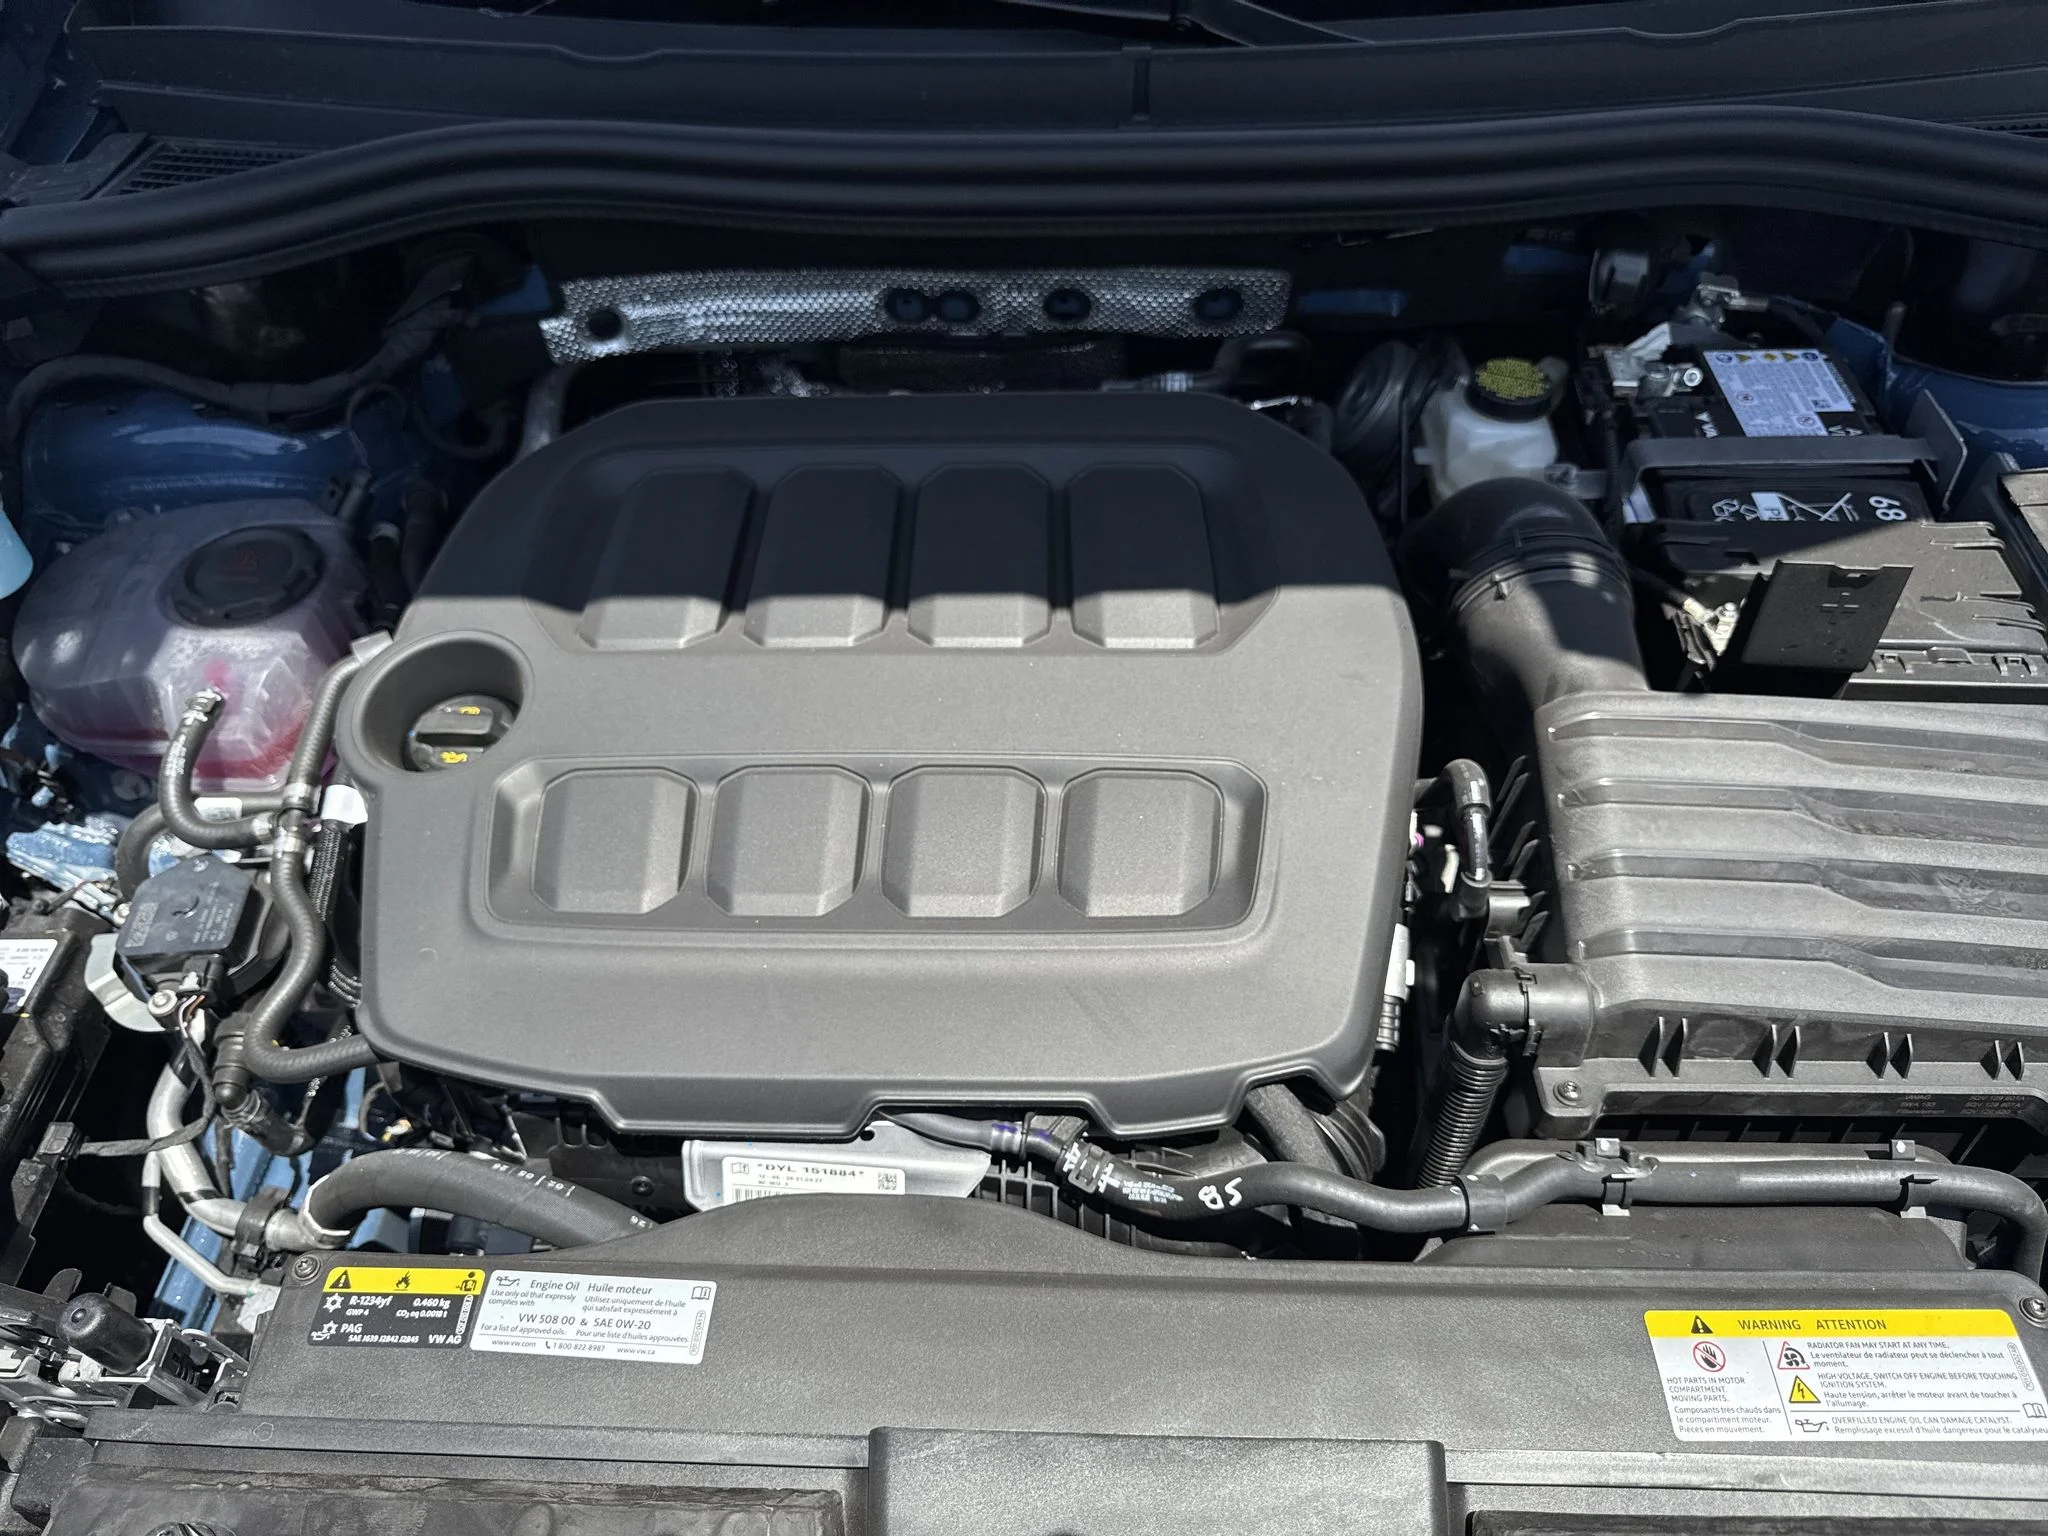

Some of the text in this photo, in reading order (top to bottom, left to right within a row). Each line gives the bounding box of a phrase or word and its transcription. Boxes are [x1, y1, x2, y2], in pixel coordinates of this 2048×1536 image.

[1868, 495, 1907, 521] 68
[530, 1279, 580, 1291] Engine Oil
[588, 1282, 653, 1295] Huile moteur
[505, 1290, 519, 1299] only
[545, 1292, 576, 1302] expressly
[585, 1295, 610, 1303] Utilisez
[612, 1297, 653, 1307] uniquement
[654, 1298, 664, 1306] de
[349, 1295, 451, 1309] R-1234yf 0.460 kg
[489, 1298, 518, 1306] complies
[582, 1304, 594, 1313] qui
[595, 1304, 622, 1313] satisfait
[624, 1306, 671, 1316] expressément
[519, 1313, 652, 1330] VW 508 00 & SAE 0W-20
[1738, 1319, 1887, 1330] WARNING ATTENTION
[340, 1323, 363, 1333] PAG
[480, 1323, 492, 1331] For
[519, 1326, 552, 1336] approved
[348, 1334, 362, 1342] SAE
[428, 1334, 446, 1344] VW
[446, 1335, 462, 1344] AG
[576, 1329, 592, 1337] Pour
[607, 1331, 620, 1339] liste
[492, 1340, 536, 1348] www.vw.com
[618, 1347, 655, 1355] www.vw.ca
[1810, 1351, 1820, 1359] Le
[1820, 1351, 1862, 1359] ventilateur
[1864, 1351, 1873, 1359] de
[1874, 1351, 1908, 1359] radiateur
[1910, 1352, 1928, 1360] peut
[1940, 1351, 1980, 1359] déclencher
[1981, 1351, 1986, 1359] à
[1824, 1391, 1846, 1399] Haute
[1848, 1391, 1880, 1400] tension,
[1881, 1391, 1906, 1399] arrêter
[1908, 1391, 1916, 1399] le
[1970, 1391, 1980, 1399] de
[1981, 1391, 2011, 1399] toucher
[2012, 1391, 2018, 1399] à
[1674, 1406, 1720, 1414] Composants
[1736, 1406, 1762, 1414] chauds
[1764, 1406, 1781, 1414] dans
[1686, 1416, 1740, 1424] compartiment
[1679, 1425, 1704, 1433] Pièces
[1835, 1426, 1882, 1435] Remplissage
[1884, 1426, 1914, 1434] excessif
[1942, 1426, 1982, 1435] dangereux
[1983, 1427, 2002, 1435] pour
[2002, 1426, 2010, 1434] le
